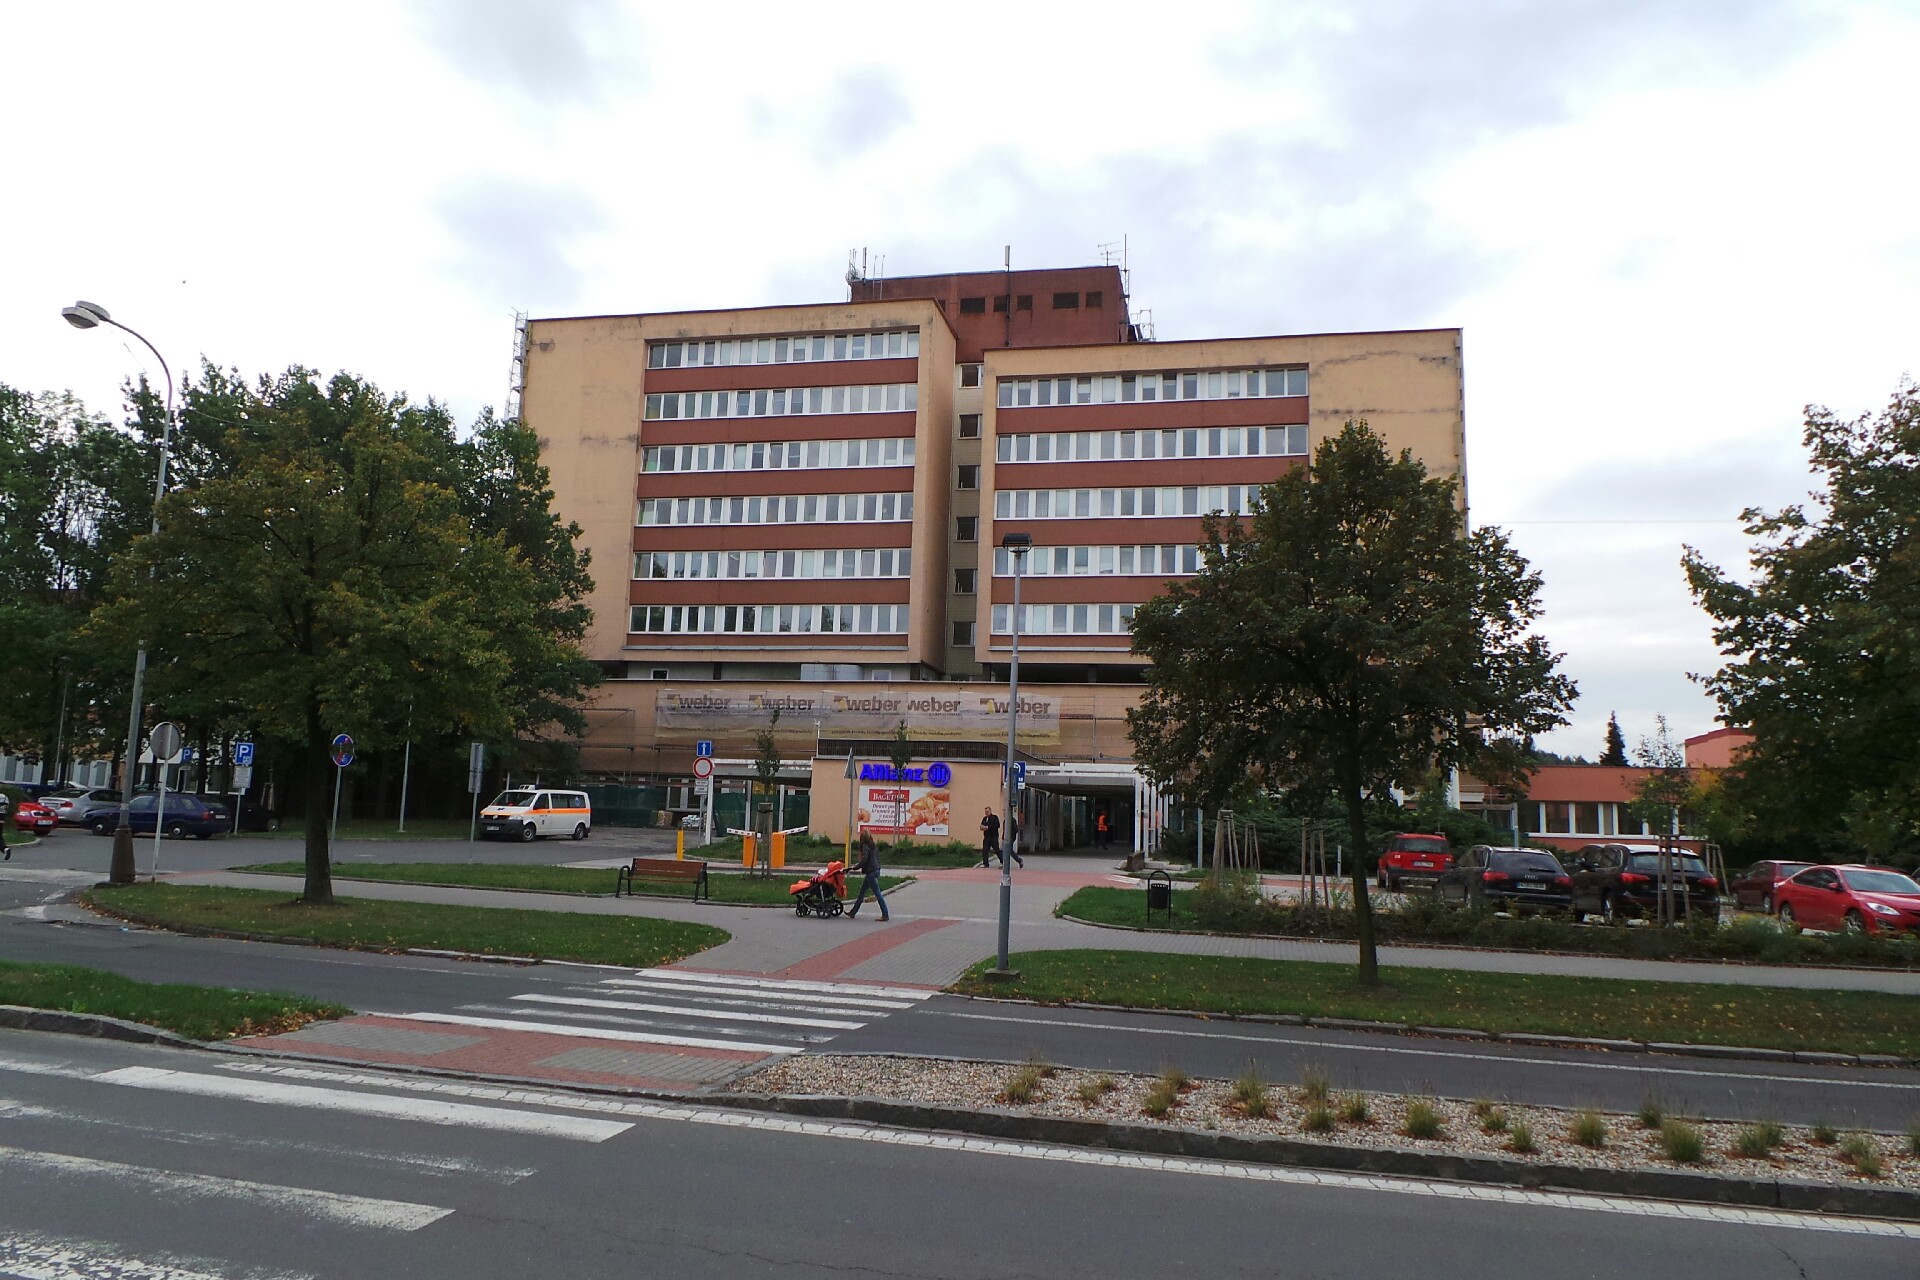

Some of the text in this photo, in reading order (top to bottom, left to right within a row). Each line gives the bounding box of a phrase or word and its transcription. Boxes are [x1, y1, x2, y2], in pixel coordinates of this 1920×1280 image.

[679, 694, 731, 710] weber
[763, 695, 815, 711] weber
[846, 695, 901, 711] weber
[907, 696, 961, 712] weber
[183, 749, 191, 760] P
[239, 745, 249, 758] P
[859, 764, 924, 782] Allianz
